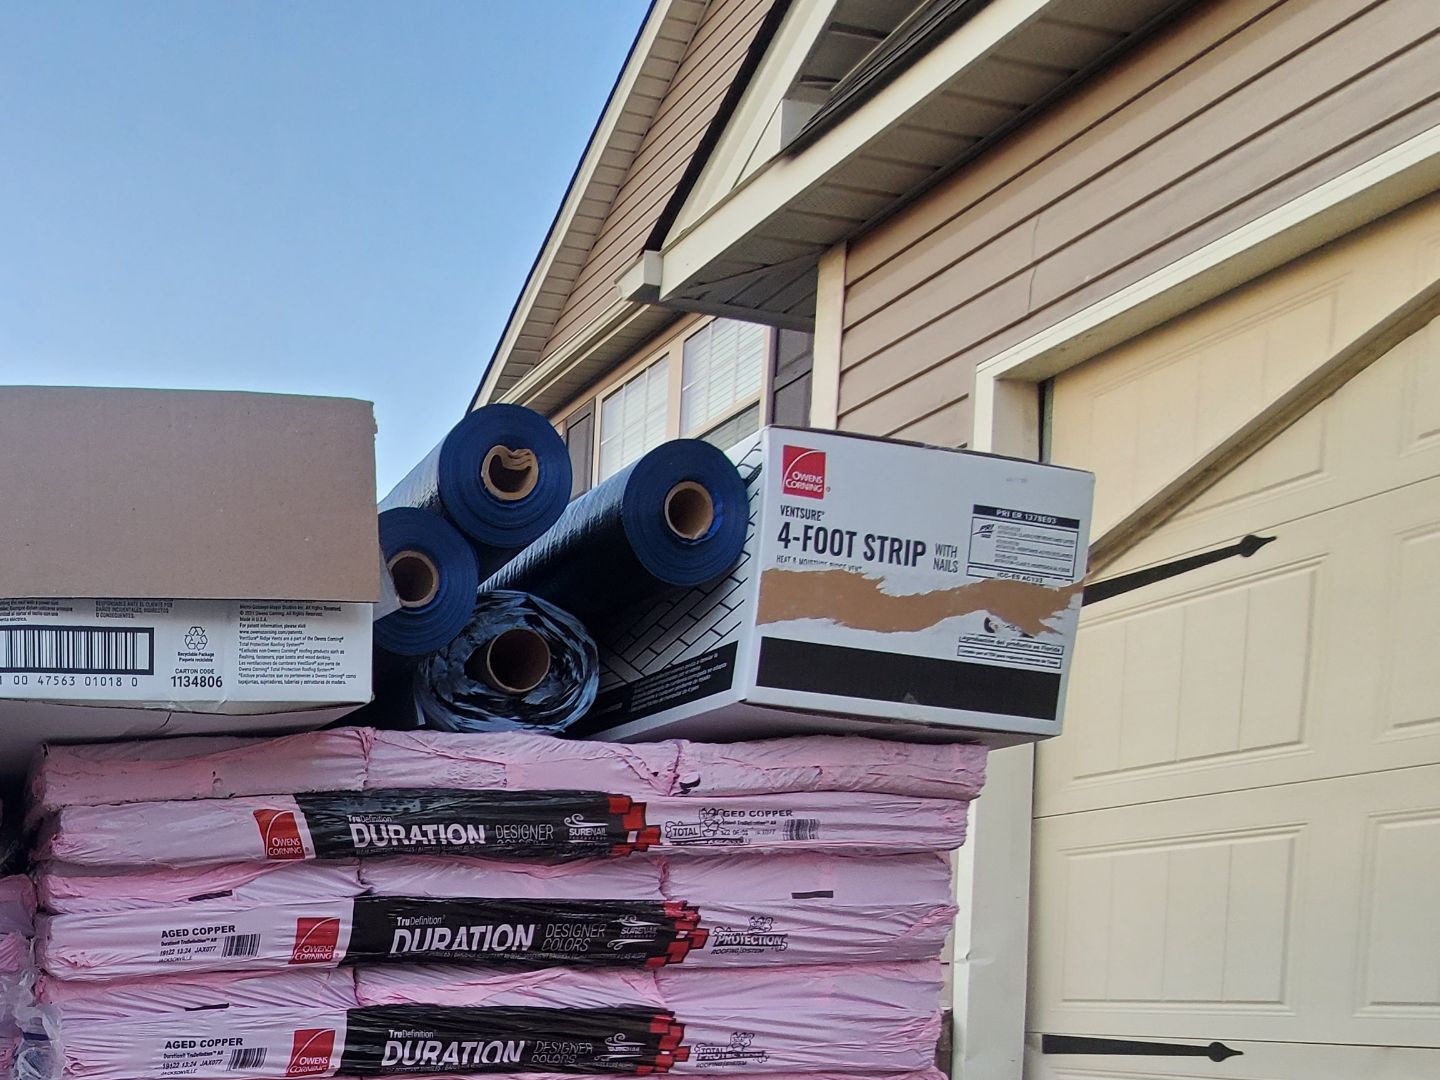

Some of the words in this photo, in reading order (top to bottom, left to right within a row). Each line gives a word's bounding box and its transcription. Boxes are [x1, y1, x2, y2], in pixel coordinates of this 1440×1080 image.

[792, 471, 823, 483] OWENS
[785, 479, 822, 493] CORNING
[777, 522, 857, 558] 4-FOOT
[863, 534, 926, 567] STRIP
[934, 543, 957, 558] WITH
[933, 559, 959, 573] NAILS
[13, 676, 28, 685] 00
[38, 676, 76, 686] 47563
[84, 677, 123, 687] 01018
[131, 677, 138, 687] 0
[171, 676, 222, 687] 1134806
[749, 809, 793, 817] COPPER
[349, 824, 486, 848] DURATION
[495, 824, 554, 839] DESIGNER
[569, 828, 608, 836] SURENAIL
[672, 827, 699, 837] TOTAL
[272, 838, 300, 847] OWENS
[268, 847, 302, 856] CORNING
[161, 929, 190, 938] AGED
[192, 924, 236, 936] COPPER
[545, 923, 606, 938] DESIGNER
[389, 924, 535, 954] DURATION
[541, 938, 591, 952] COLORS
[715, 935, 782, 945] PROTECTION
[302, 944, 334, 953] OWENS
[294, 952, 332, 961] CORNING
[165, 1040, 196, 1049] AGED
[199, 1037, 243, 1047] COPPER
[534, 1041, 593, 1054] DESIGNER
[381, 1040, 525, 1066] DURATION
[299, 1057, 328, 1065] OWENS
